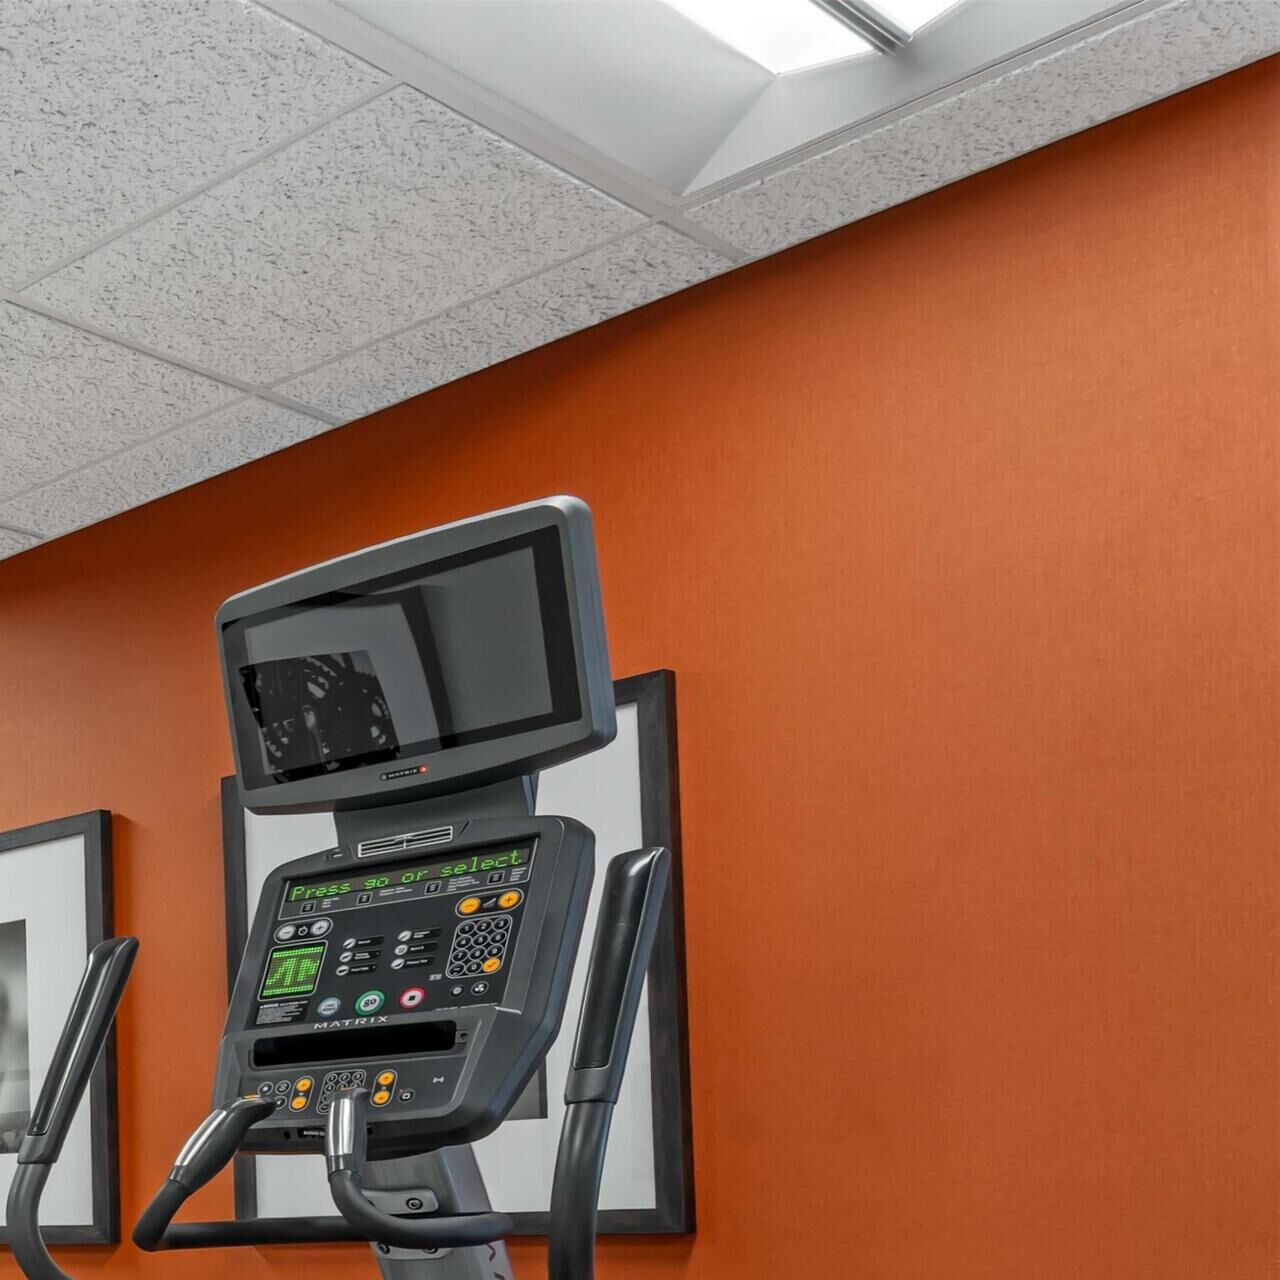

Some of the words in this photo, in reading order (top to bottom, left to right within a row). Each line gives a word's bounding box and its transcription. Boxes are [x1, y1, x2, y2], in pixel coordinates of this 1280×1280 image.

[291, 881, 351, 901] Press
[364, 877, 389, 890] go
[401, 871, 428, 883] or
[440, 850, 521, 878] select
[362, 998, 377, 1008] go
[314, 1015, 389, 1030] MATRIX
